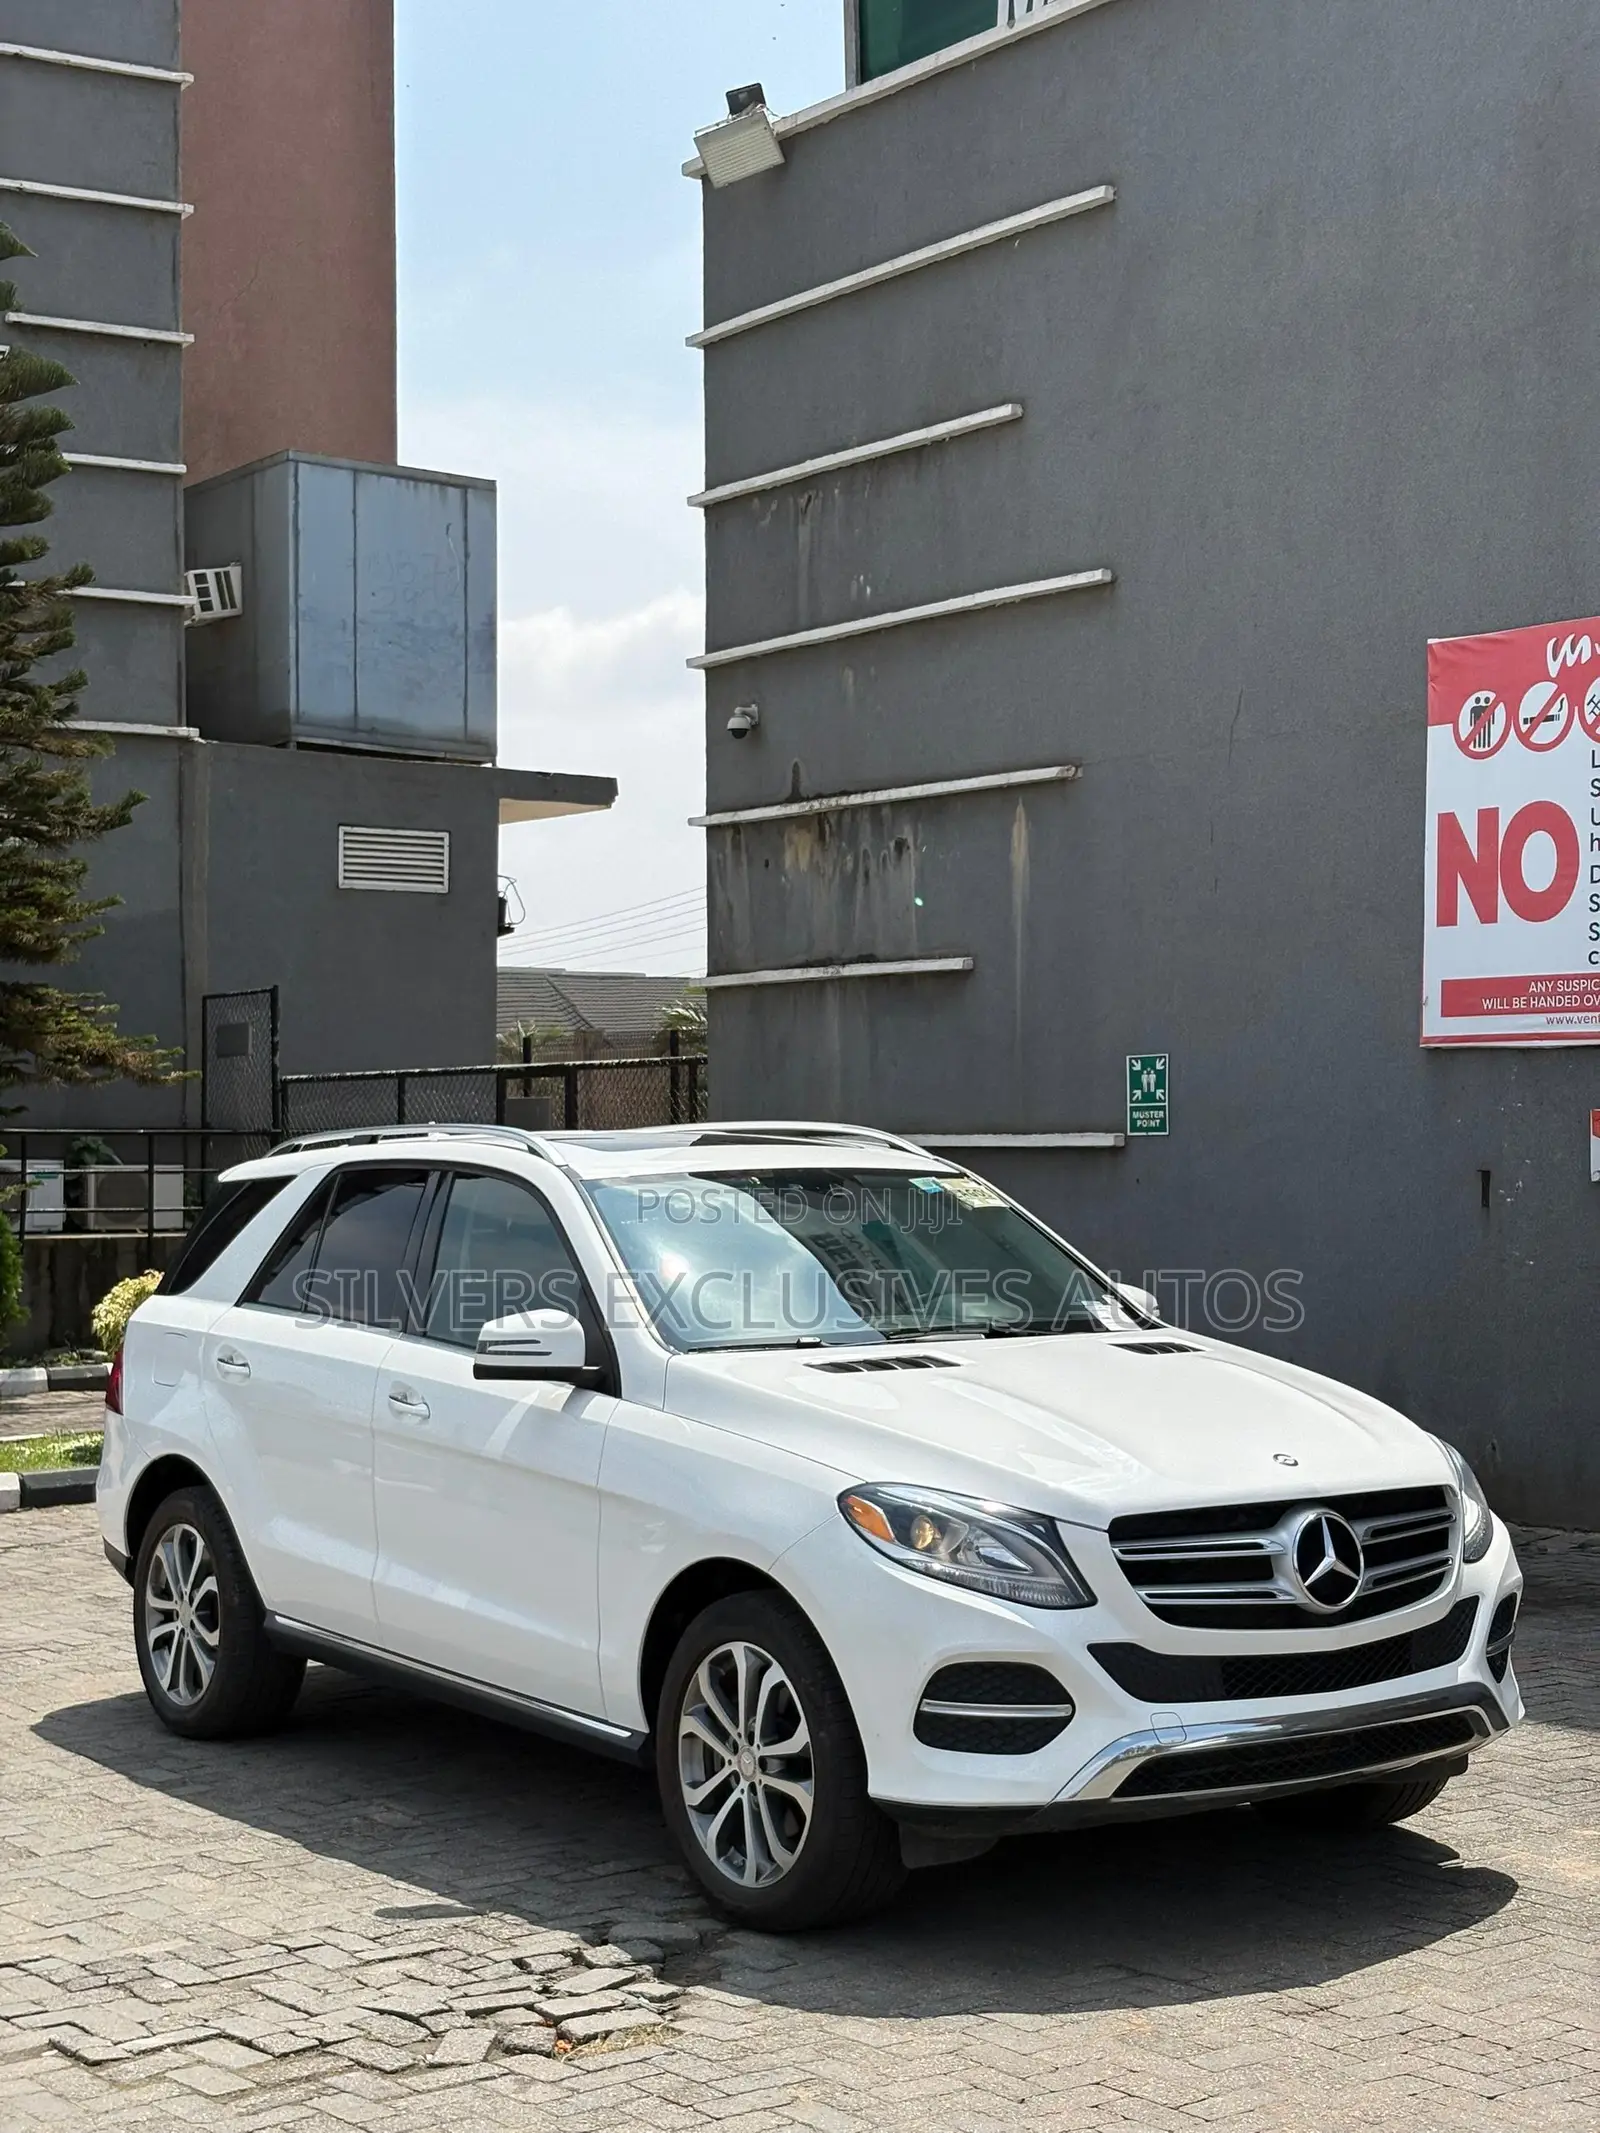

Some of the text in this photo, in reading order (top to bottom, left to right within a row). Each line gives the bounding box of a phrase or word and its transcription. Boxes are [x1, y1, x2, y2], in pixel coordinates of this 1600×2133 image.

[1436, 800, 1580, 928] NO
[1528, 980, 1554, 993] ANY
[1482, 997, 1510, 1010] WILL
[1512, 996, 1528, 1009] BE
[1530, 994, 1581, 1008] HANDED
[1132, 1110, 1164, 1119] MUSTER
[1136, 1119, 1160, 1127] POINT
